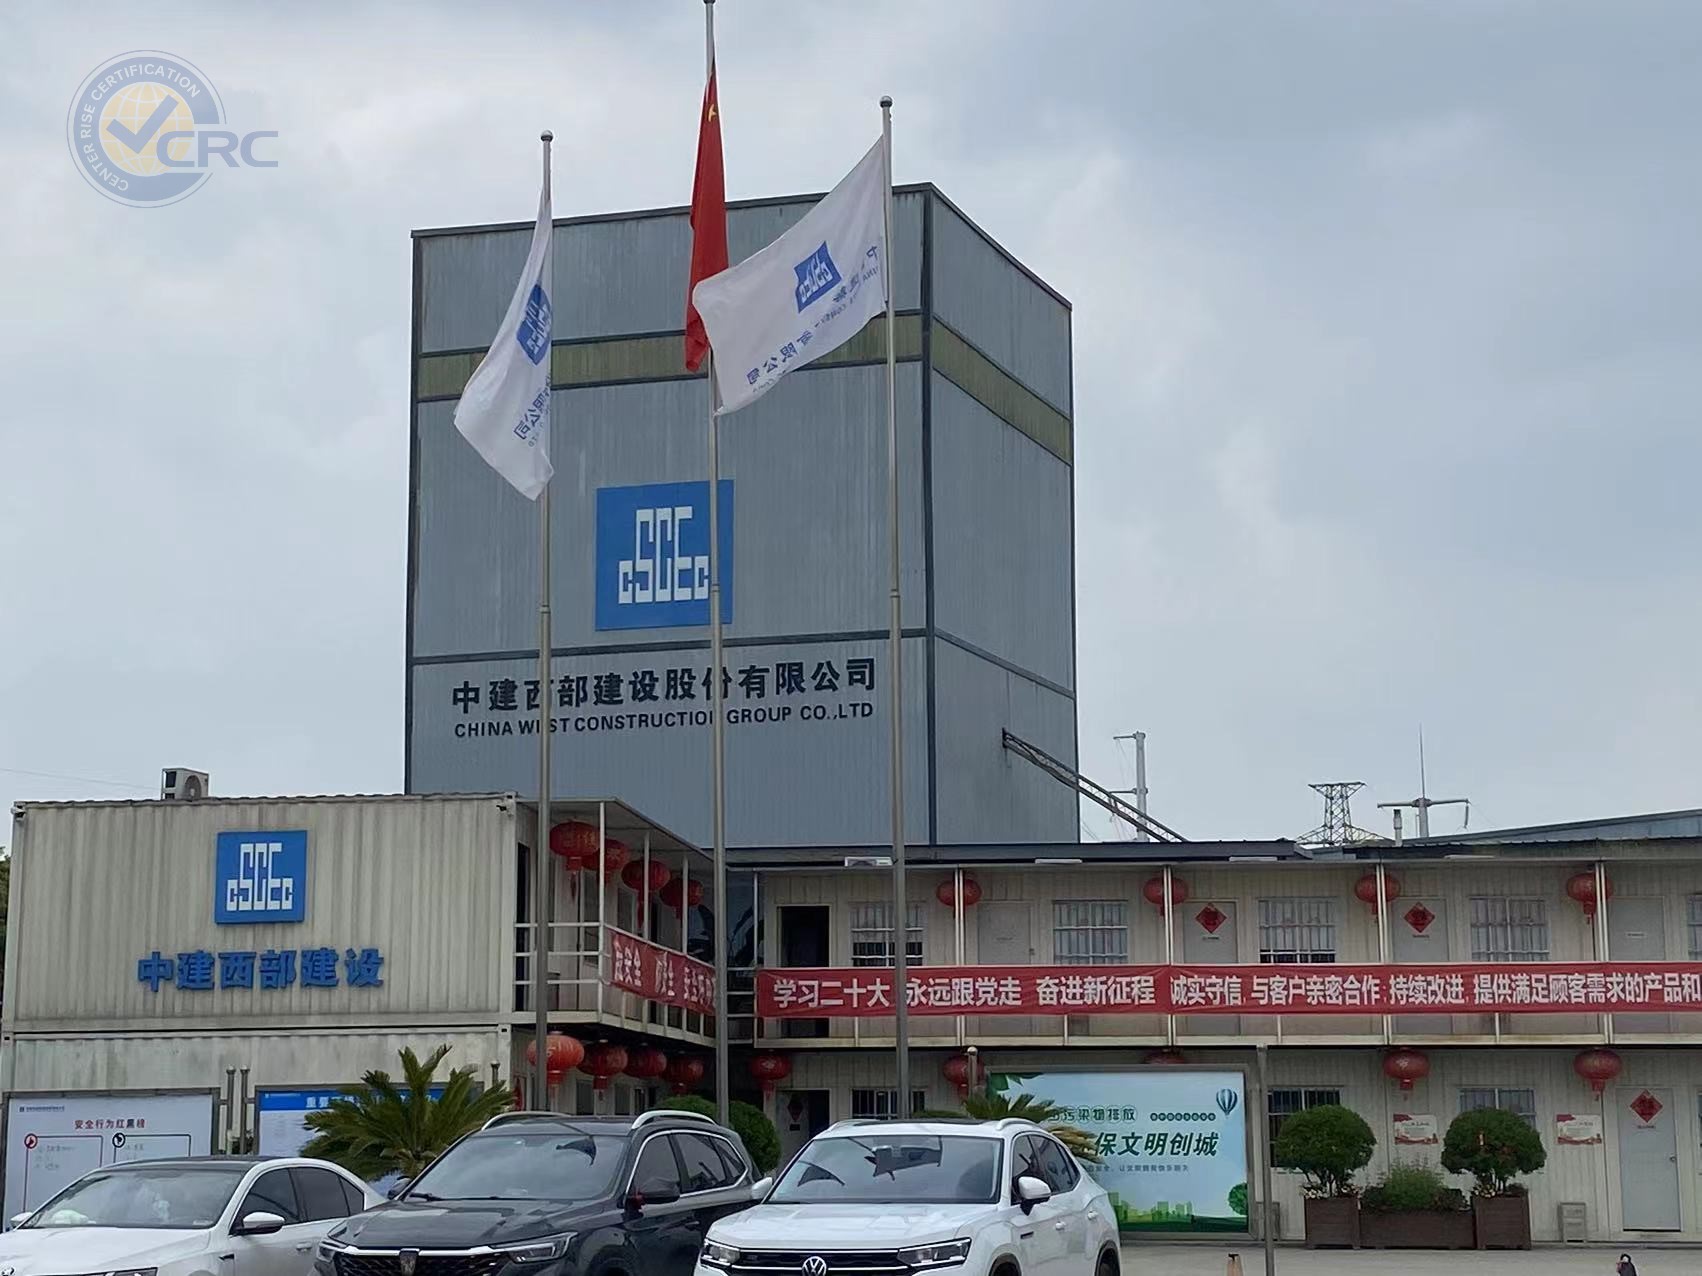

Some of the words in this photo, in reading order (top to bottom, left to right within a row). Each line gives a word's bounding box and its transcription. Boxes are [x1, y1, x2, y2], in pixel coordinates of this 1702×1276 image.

[454, 720, 513, 738] CHINA
[726, 706, 792, 725] GROUP
[800, 702, 874, 721] CO.,LTD
[137, 947, 385, 993] 中建西部建设
[773, 978, 890, 1008] 学习二十大
[906, 975, 1022, 1007] 永远跟党走
[1036, 974, 1157, 1006] 奋进新征程
[1094, 1131, 1220, 1157] 保文明创城
